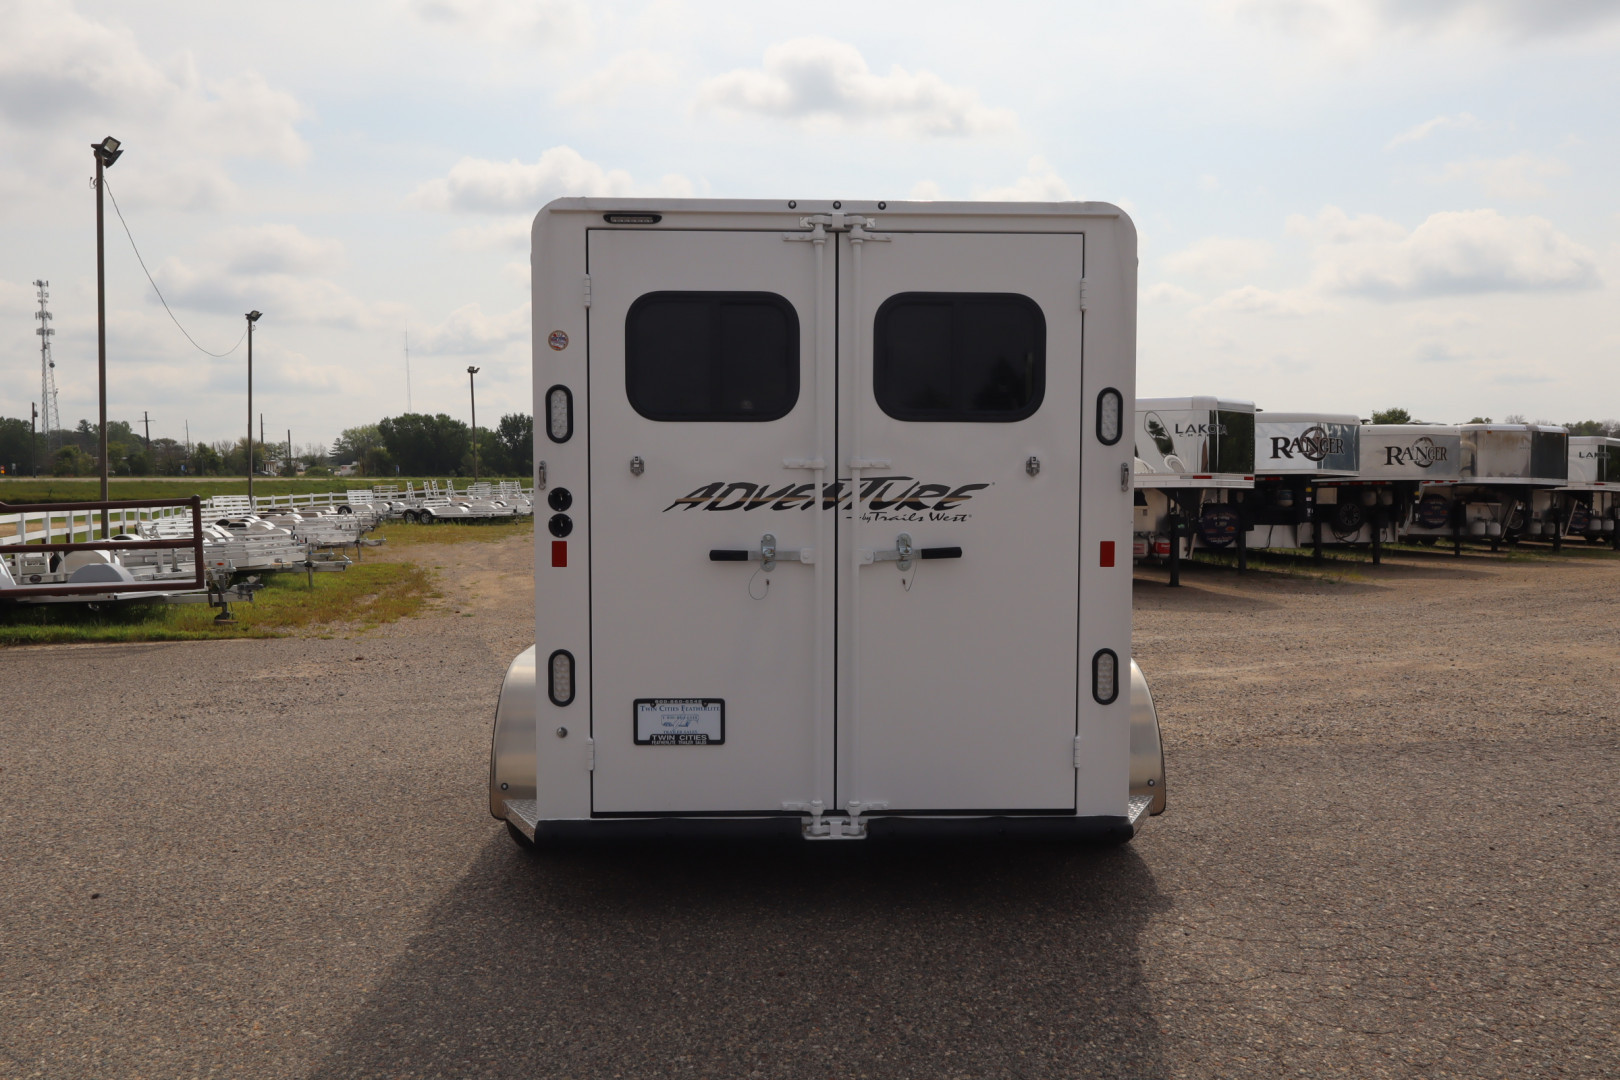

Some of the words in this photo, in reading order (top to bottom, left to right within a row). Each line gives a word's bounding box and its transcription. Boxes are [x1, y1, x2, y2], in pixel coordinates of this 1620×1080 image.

[1270, 436, 1345, 459] RANGER
[1384, 445, 1448, 466] RANGER
[662, 476, 990, 512] ADVENTURE
[869, 511, 924, 522] Trails
[928, 511, 968, 522] West
